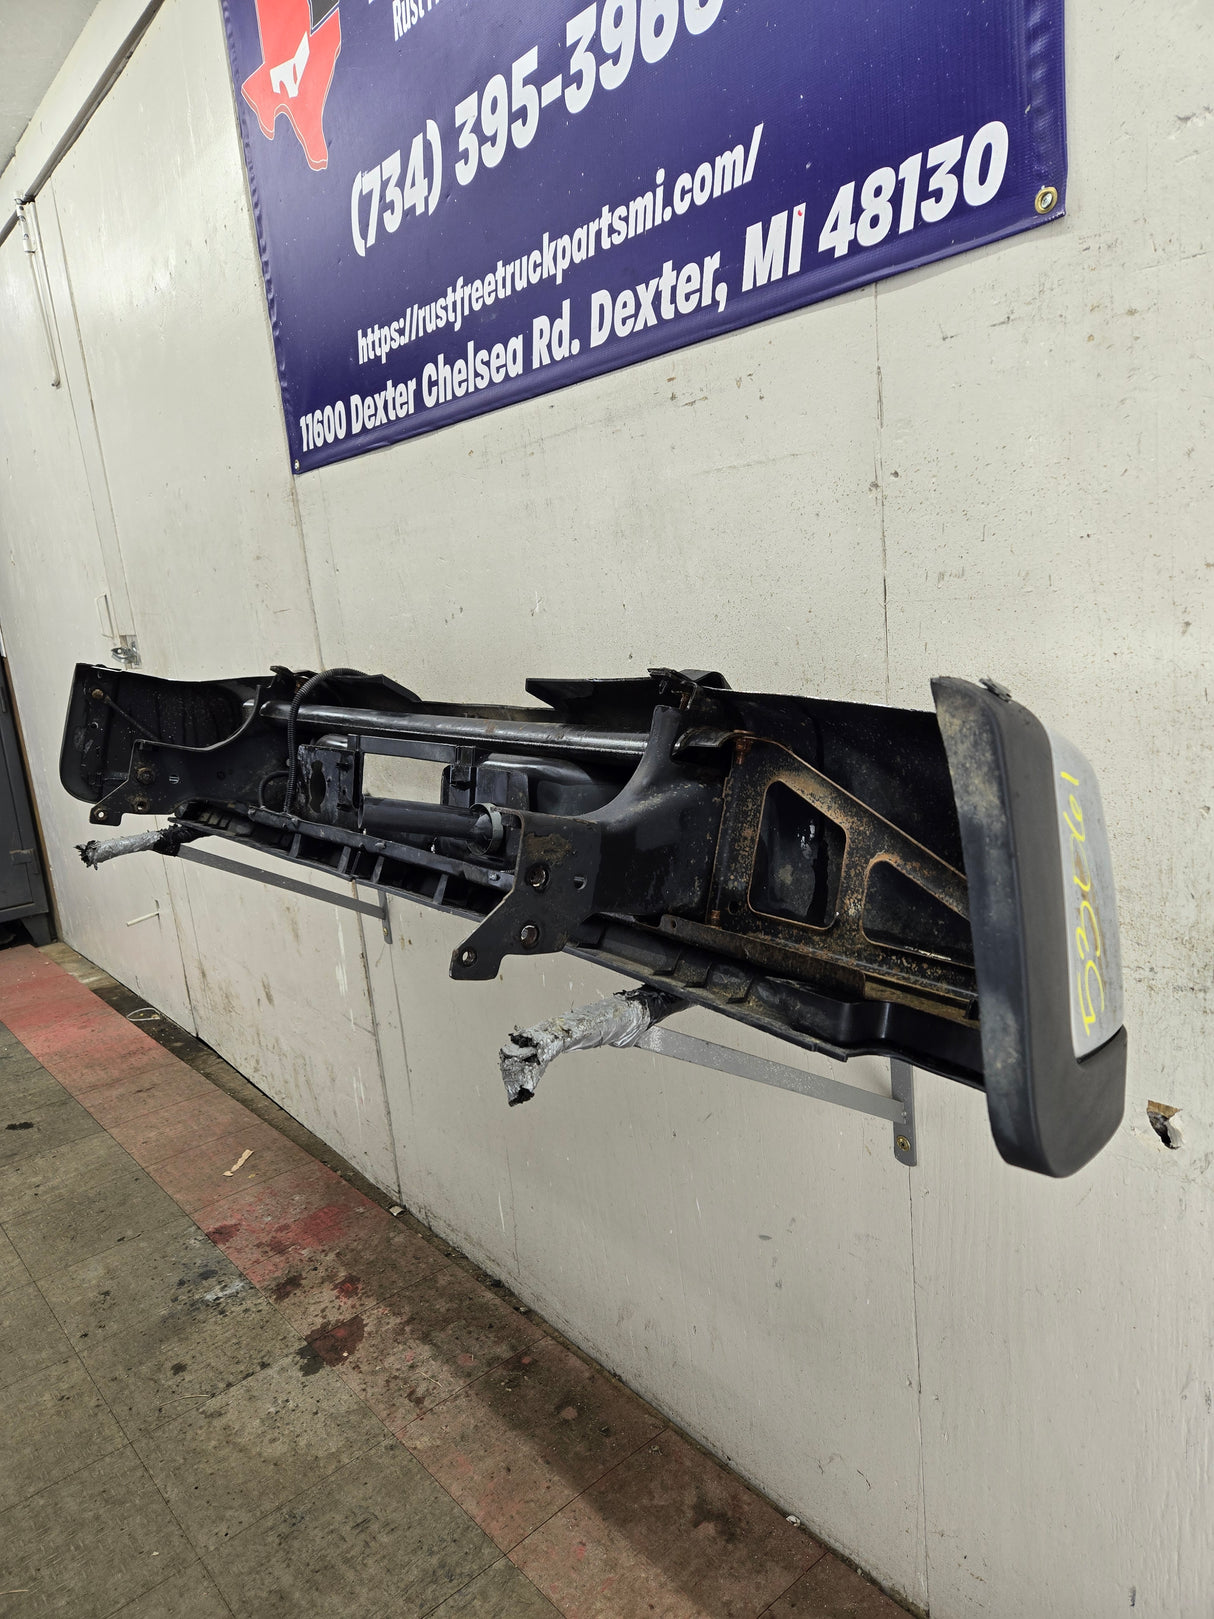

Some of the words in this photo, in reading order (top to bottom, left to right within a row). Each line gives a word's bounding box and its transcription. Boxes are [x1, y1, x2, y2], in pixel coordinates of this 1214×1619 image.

[299, 400, 347, 452] 11600
[350, 378, 417, 435] Dexter
[422, 333, 524, 408] Chelsea
[532, 299, 581, 370] Rd.
[590, 250, 728, 349] Dexter,
[742, 203, 807, 292] MI
[818, 120, 1009, 259] 48130
[351, 119, 443, 257] (734)
[357, 123, 764, 365] https://rustfreetruckpartsmi.com/
